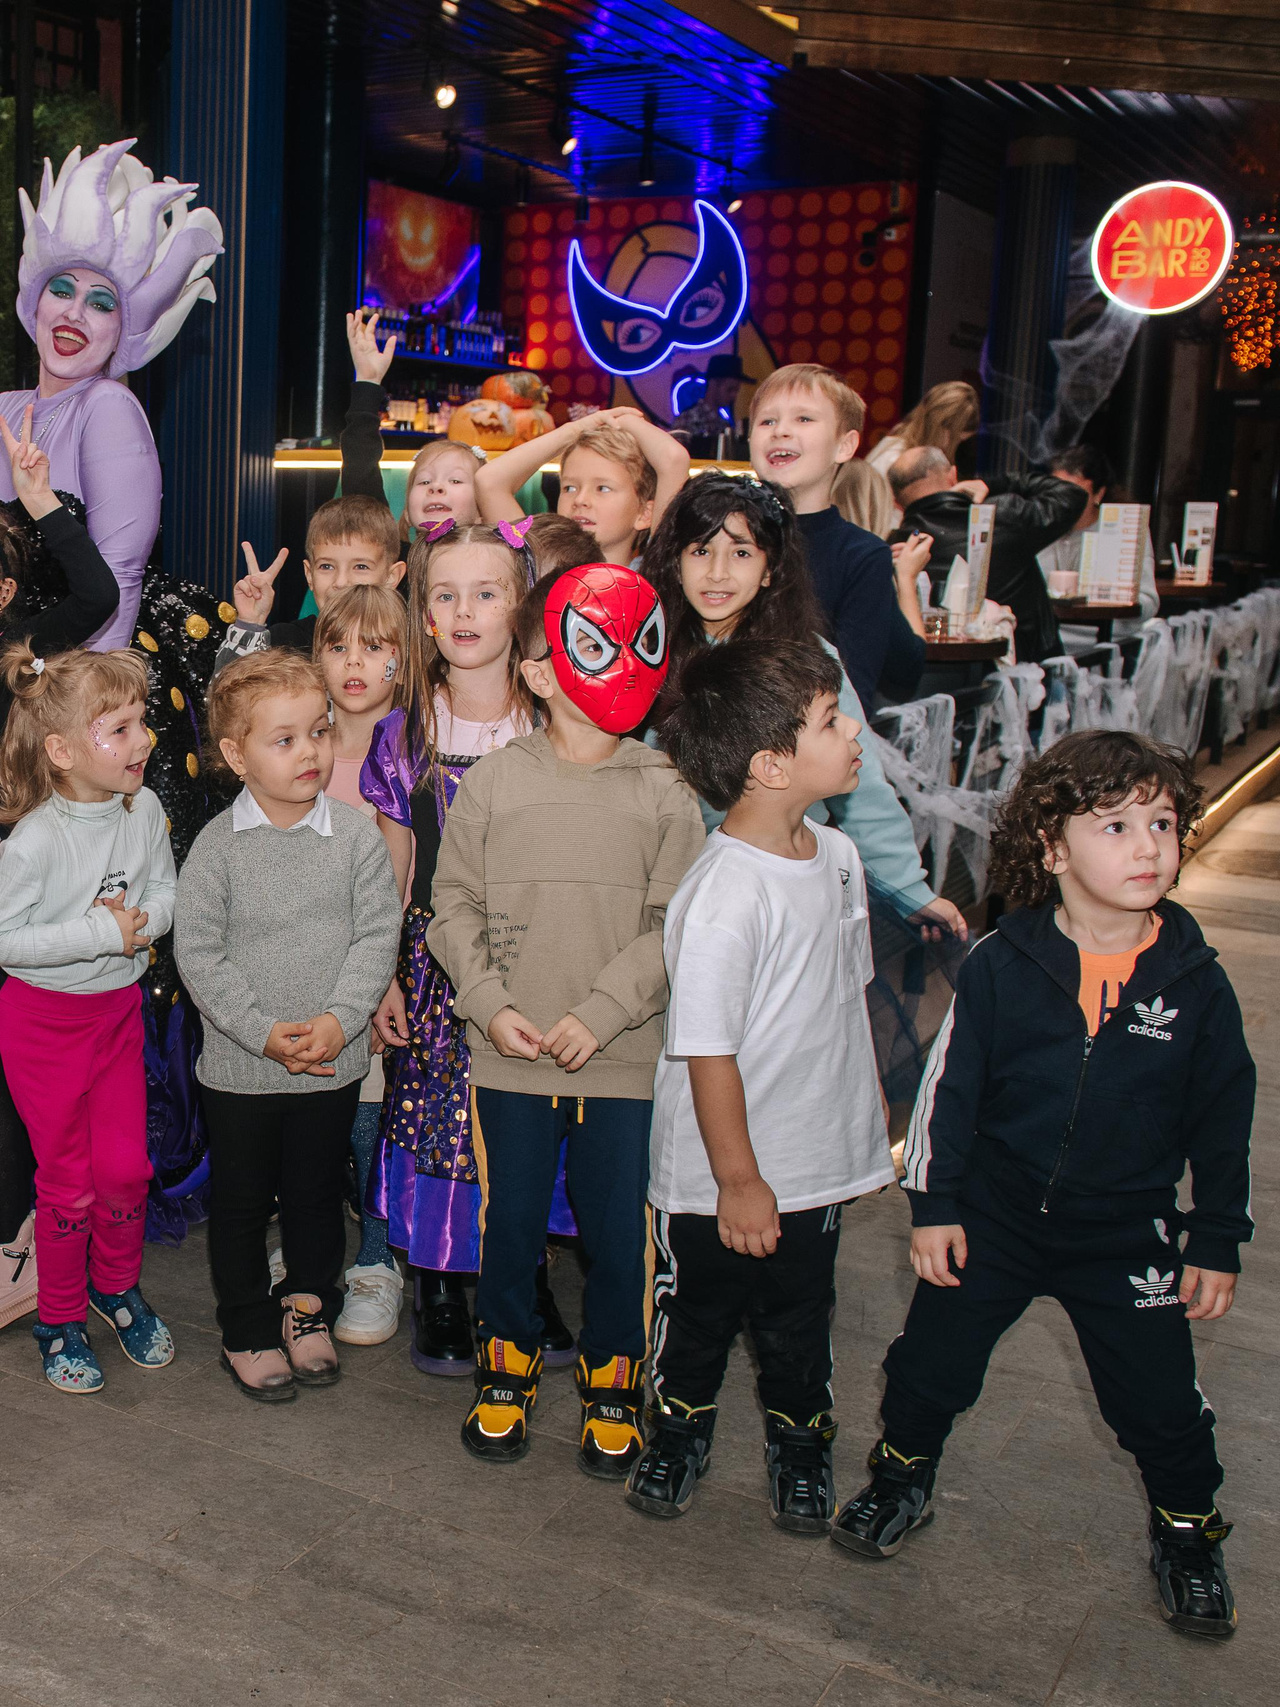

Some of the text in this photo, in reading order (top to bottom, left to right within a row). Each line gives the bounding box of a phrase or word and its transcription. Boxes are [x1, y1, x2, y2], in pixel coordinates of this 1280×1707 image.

[1111, 217, 1214, 250] ANDY
[1110, 249, 1188, 280] BAR
[1127, 1023, 1173, 1041] adidas
[1134, 1294, 1179, 1308] adidas
